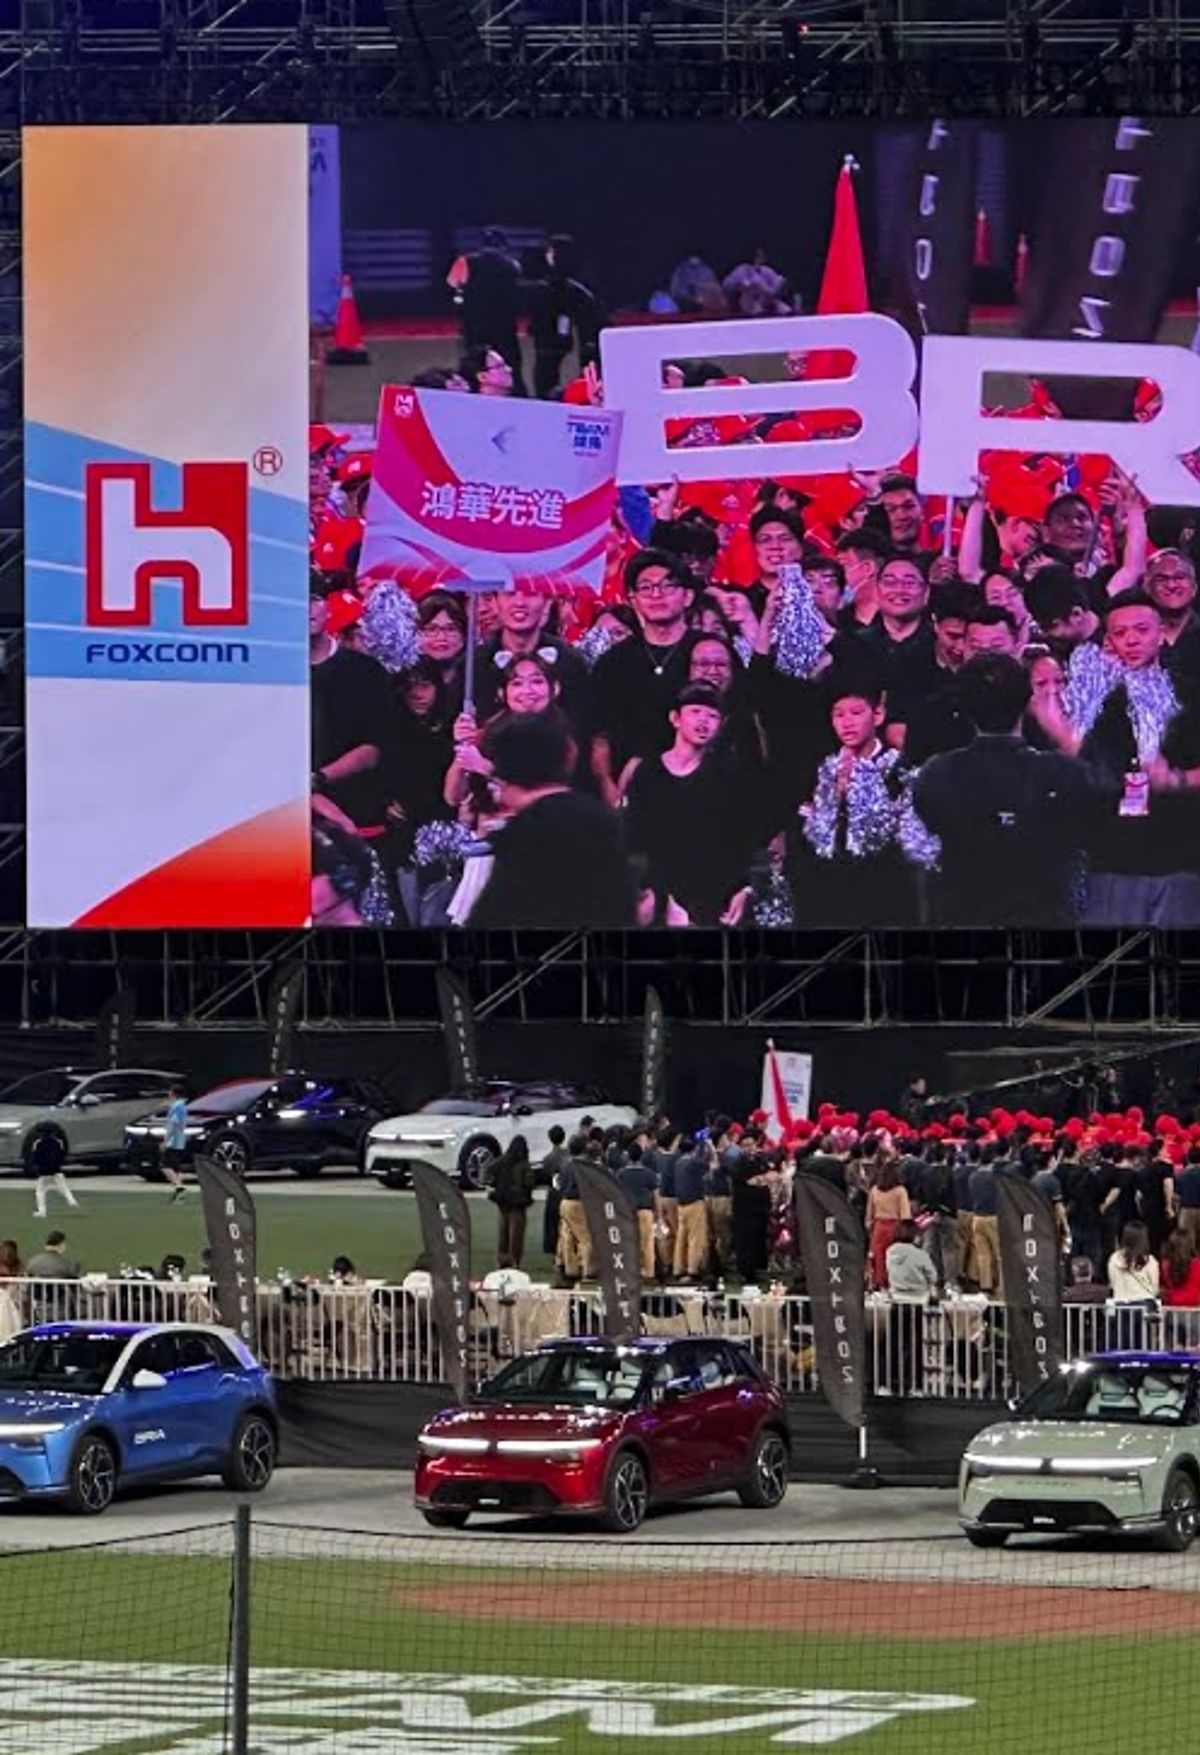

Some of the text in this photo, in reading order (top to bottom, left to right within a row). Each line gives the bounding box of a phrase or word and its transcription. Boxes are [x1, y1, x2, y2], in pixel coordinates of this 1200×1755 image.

[420, 480, 565, 530] 鴻華先進
[86, 643, 249, 663] FOXCONN
